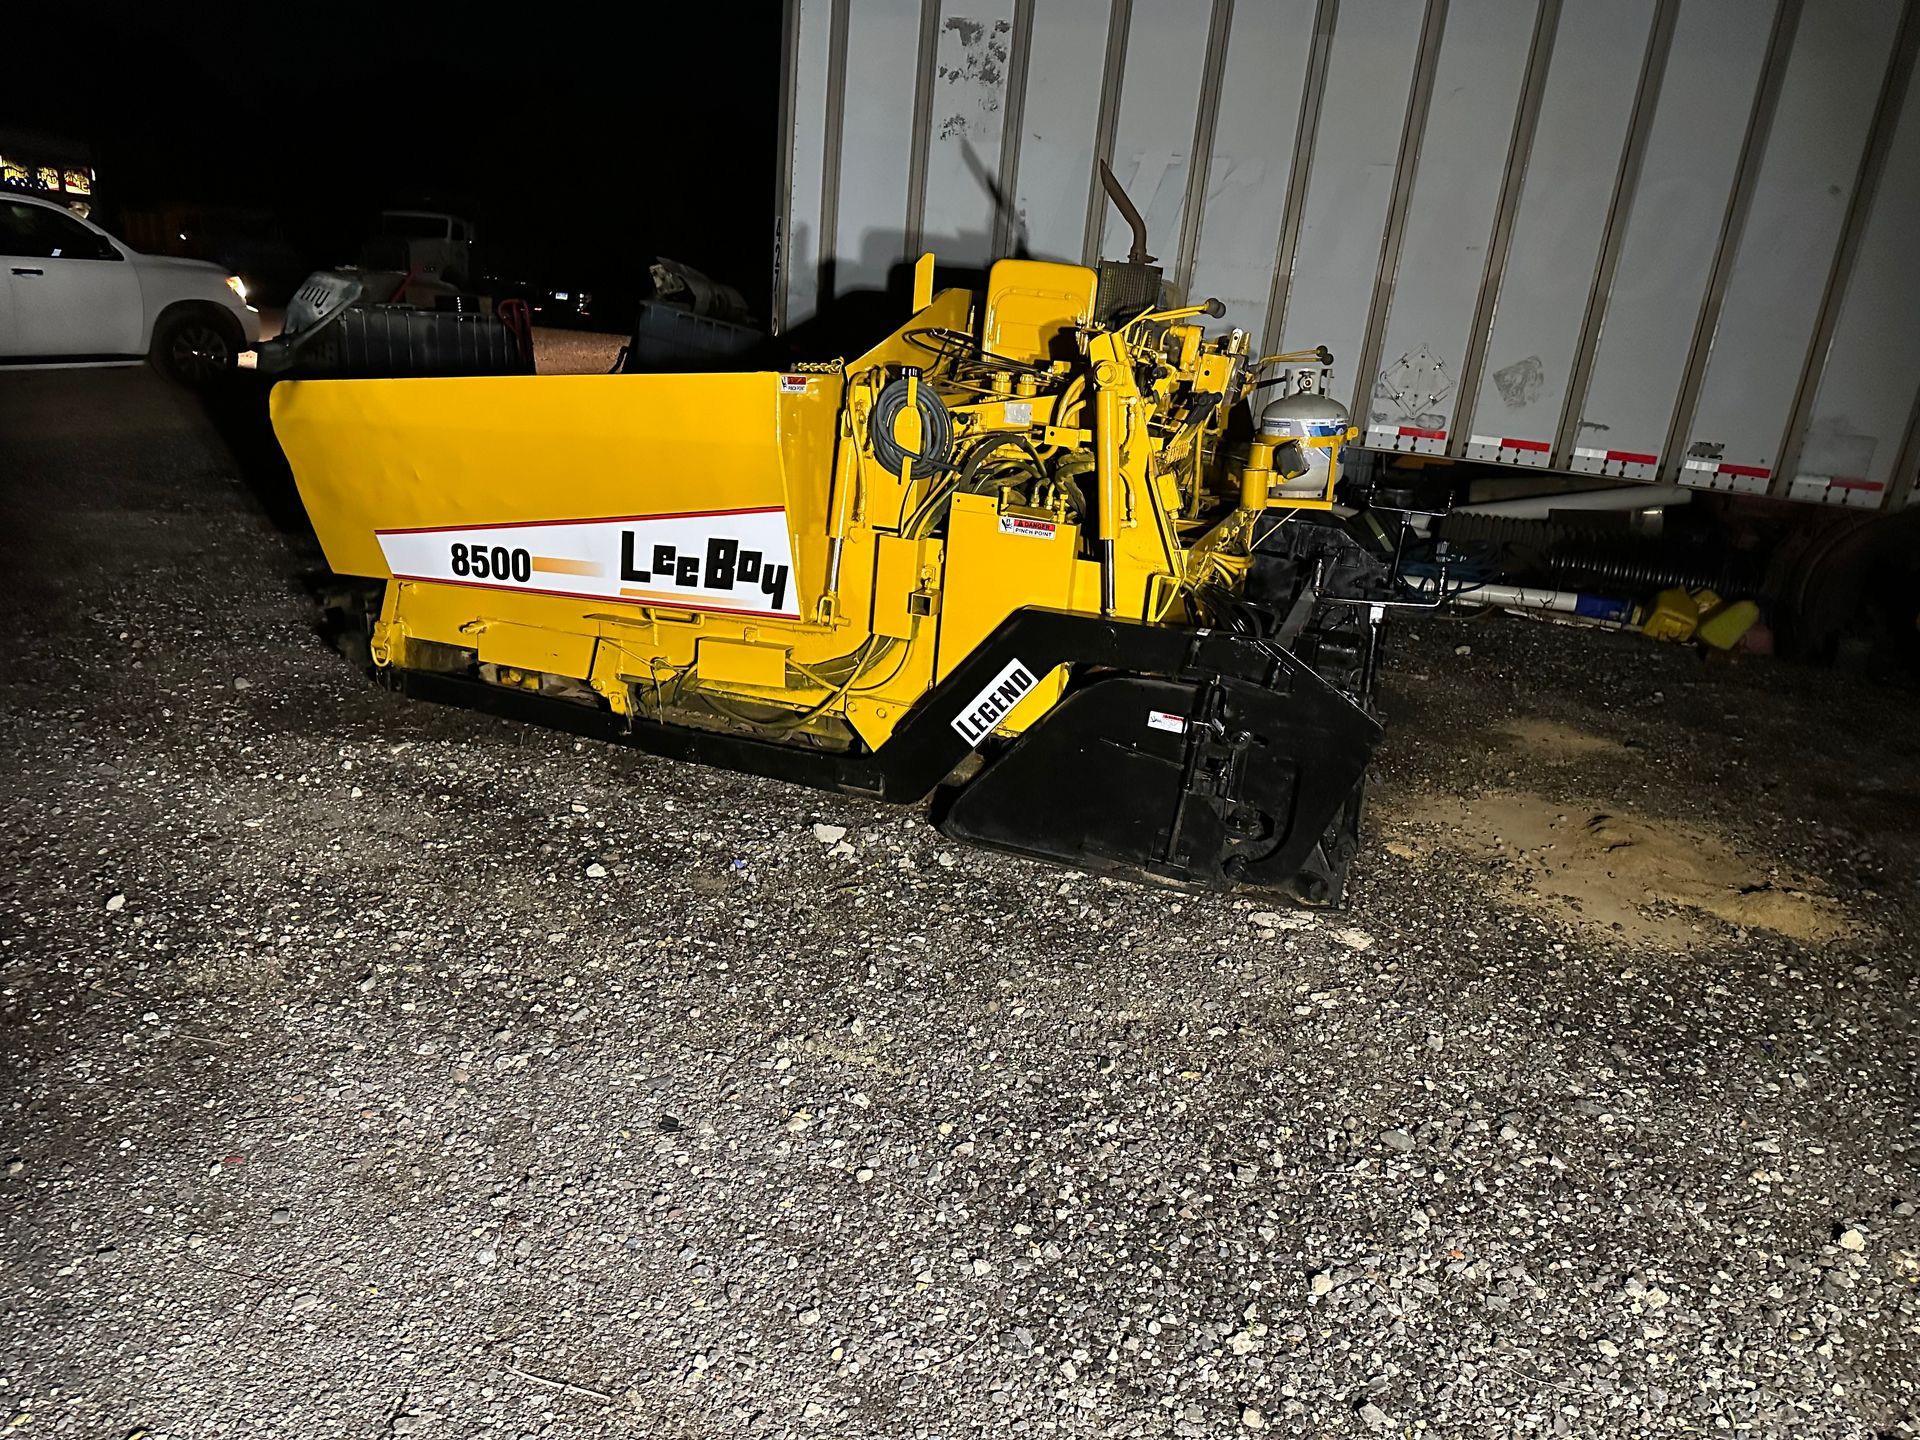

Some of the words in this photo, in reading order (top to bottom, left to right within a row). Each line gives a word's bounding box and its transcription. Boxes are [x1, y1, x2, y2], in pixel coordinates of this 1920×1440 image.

[1024, 520, 1050, 531] DANGER
[451, 543, 531, 583] 8500
[621, 531, 789, 610] LeeBoy
[956, 668, 1033, 741] LEGEND
